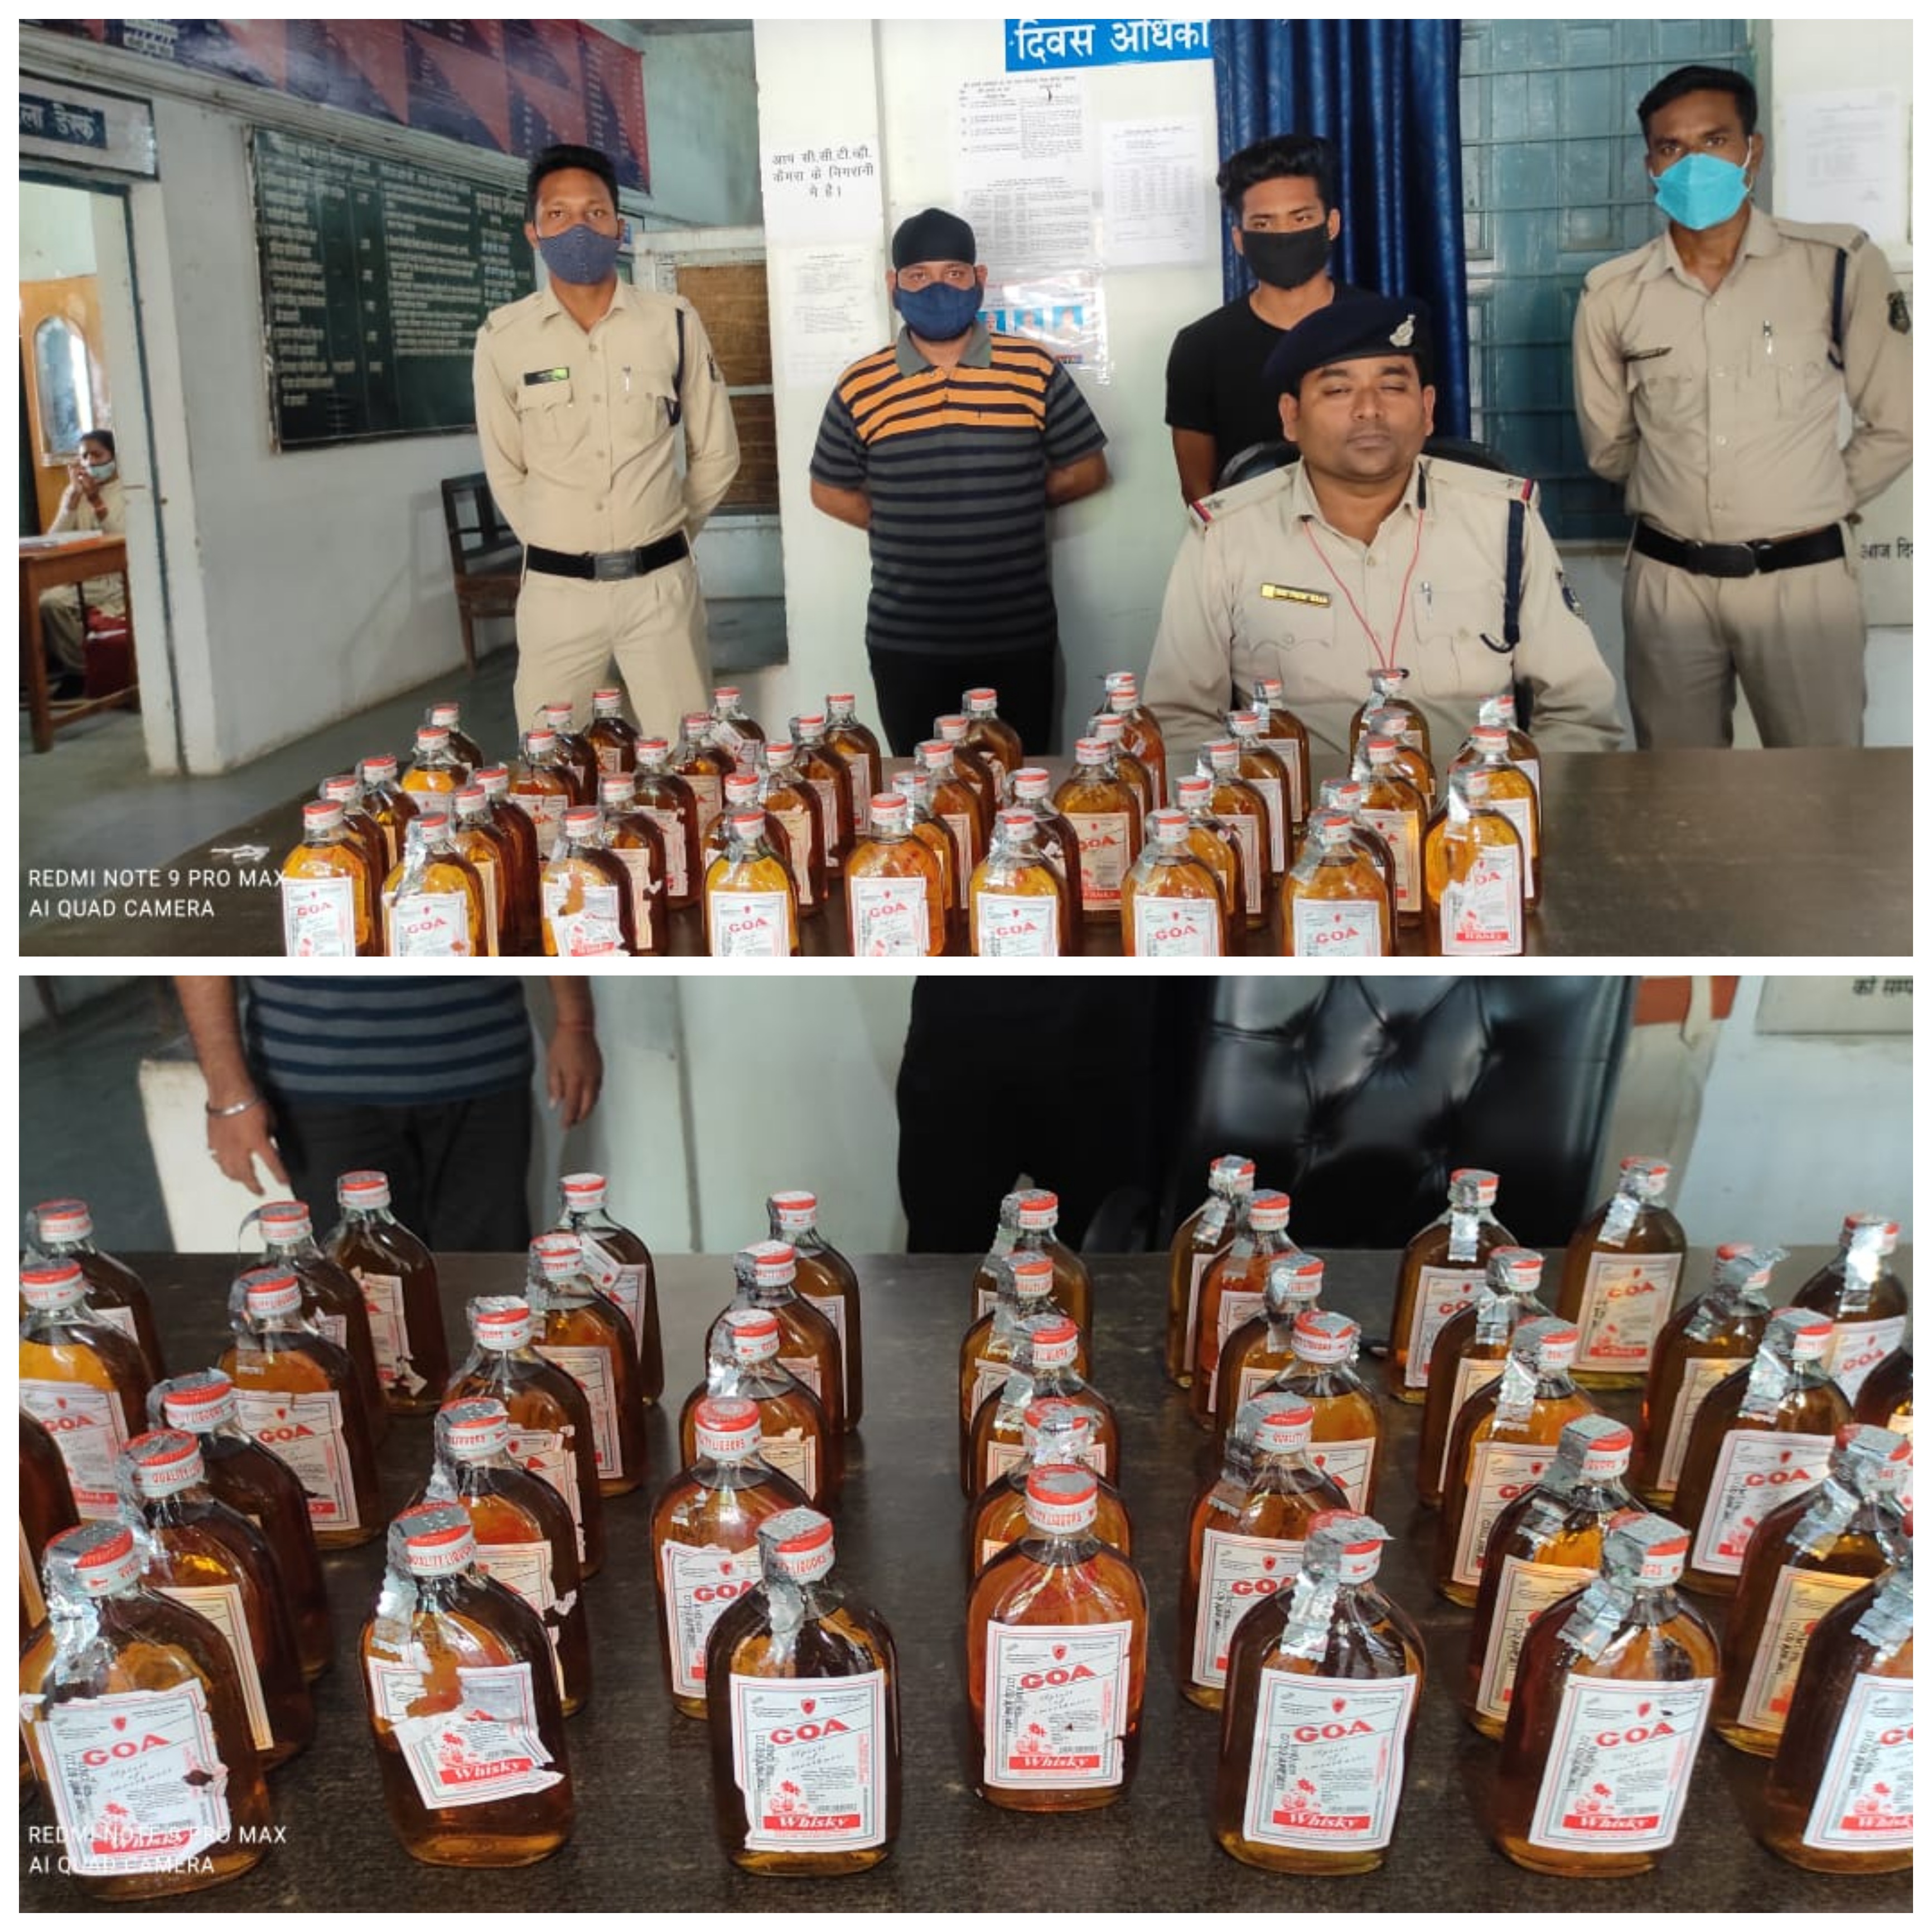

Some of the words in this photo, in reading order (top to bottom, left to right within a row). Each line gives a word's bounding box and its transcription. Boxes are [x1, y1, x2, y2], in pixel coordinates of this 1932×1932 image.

[1015, 19, 1094, 63] दिवस
[297, 901, 332, 916] GOA
[868, 902, 909, 919] GOA
[407, 916, 448, 935] GOA
[728, 916, 768, 934] GOA
[996, 920, 1037, 936] GOA
[1155, 924, 1198, 941] GOA
[1315, 926, 1360, 944] GOA
[1606, 1282, 1655, 1298] GOA
[1842, 1349, 1885, 1371] GOA
[258, 1423, 315, 1443] GOA
[1745, 1469, 1811, 1487] GOA
[1020, 1664, 1097, 1689] GOA
[770, 1718, 852, 1745] GOA
[1293, 1718, 1375, 1743] GOA
[1596, 1721, 1675, 1747] GOA
[82, 1733, 172, 1766] GOA
[455, 1760, 520, 1780] Whisky
[1024, 1757, 1089, 1770] Whisky
[780, 1815, 850, 1828] Whisky
[1289, 1813, 1358, 1830] Whisky
